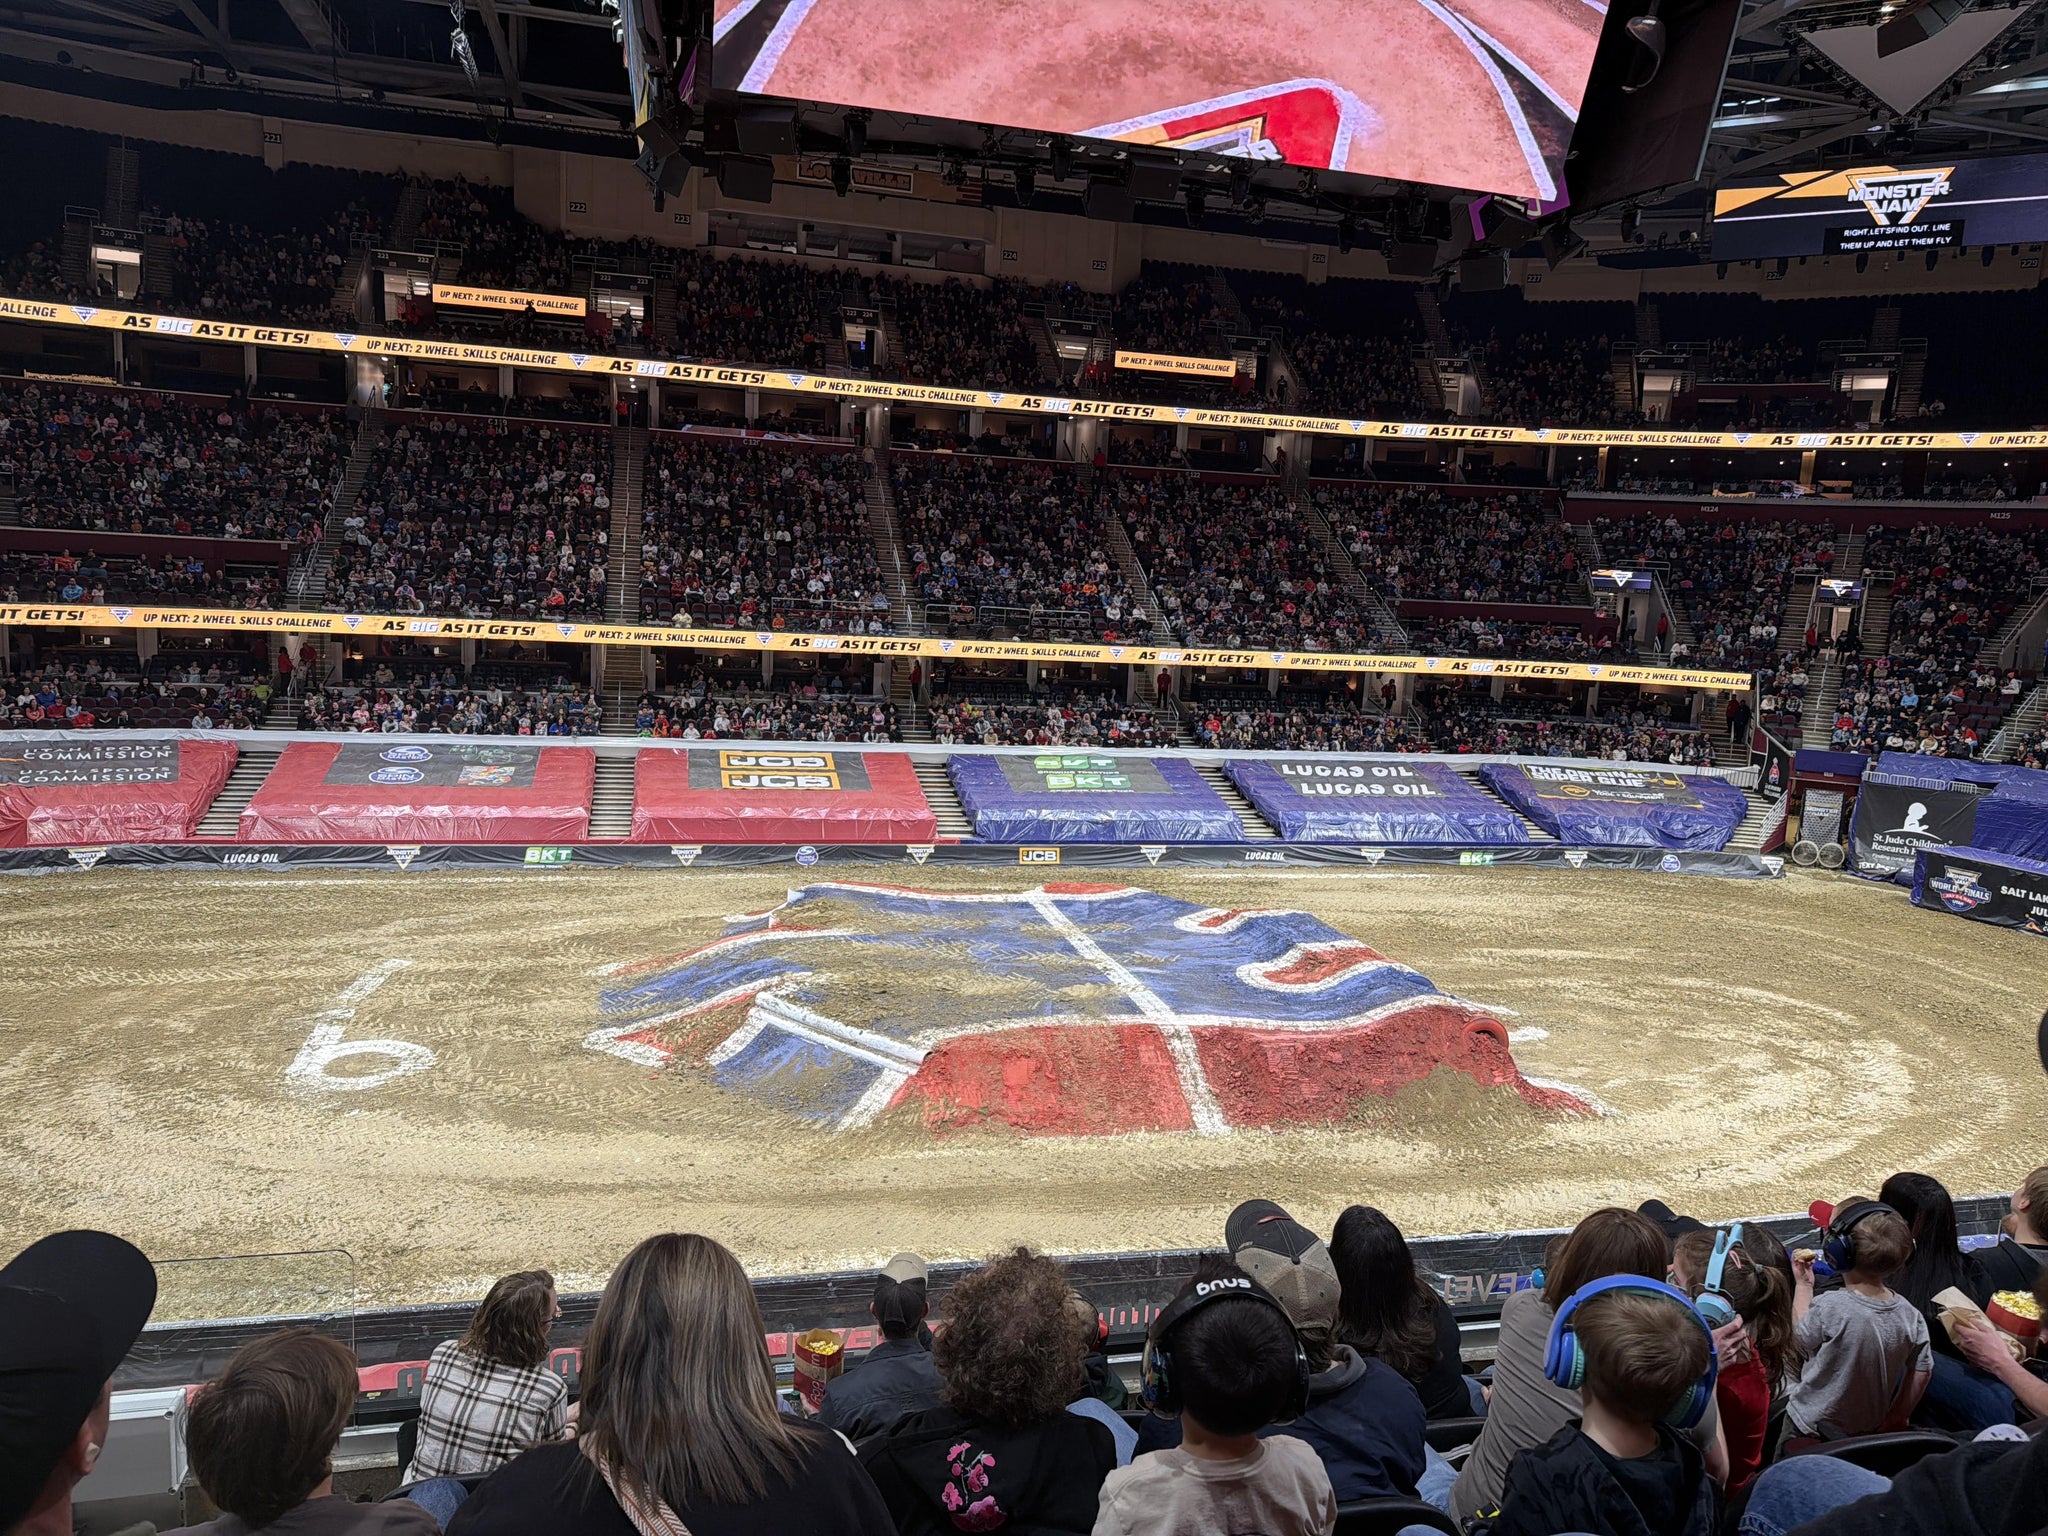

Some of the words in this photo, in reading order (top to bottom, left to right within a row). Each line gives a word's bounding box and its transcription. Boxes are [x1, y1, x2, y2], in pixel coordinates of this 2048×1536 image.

[264, 133, 280, 142] 221
[1848, 181, 1950, 202] MONSTER
[571, 203, 586, 211] 222
[1874, 198, 1920, 213] JAM
[675, 215, 690, 223] 223
[1932, 223, 1951, 231] LINE
[1840, 242, 1862, 250] THEM
[1935, 236, 1952, 244] FLY
[440, 290, 450, 298] UP
[452, 292, 474, 301] NEXT:
[482, 294, 507, 304] WHEEL
[509, 297, 535, 306] SKILLS
[537, 300, 579, 310] CHALLENGE
[0, 302, 58, 317] ALLENGE
[123, 316, 152, 328] AS
[156, 320, 194, 332] BIG
[196, 324, 225, 335] AS
[228, 327, 249, 337] IT
[254, 330, 311, 344] GETS!
[367, 340, 380, 349] UP
[381, 342, 413, 352] NEXT:
[416, 345, 423, 353] 2
[425, 345, 461, 356] WHEEL
[463, 348, 497, 359] SKILLS
[500, 352, 558, 364] CHALLENGE
[1153, 359, 1174, 367] WHEEL
[1175, 361, 1195, 369] SKILLS
[1196, 363, 1230, 372] CHALLENGE
[610, 361, 634, 371] AS
[636, 363, 668, 375] BIG
[670, 366, 693, 377] AS
[695, 368, 715, 378] IT
[718, 370, 766, 384] GETS!
[814, 380, 827, 388] UP
[828, 382, 853, 391] NEXT:
[864, 385, 895, 394] WHEEL
[896, 388, 927, 396] SKILLS
[928, 391, 978, 402] CHALLENGE
[1021, 398, 1042, 408] AS
[1044, 400, 1071, 411] BIG
[1072, 403, 1093, 411] AS
[1094, 404, 1111, 413] IT
[1113, 406, 1155, 417] GETS!
[1380, 425, 1400, 434] AS
[1430, 427, 1450, 436] AS
[1452, 428, 1469, 436] IT
[1471, 429, 1514, 439] GETS!
[1571, 433, 1596, 441] NEXT:
[1605, 434, 1635, 442] WHEEL
[1670, 435, 1723, 443] CHALLENGE
[1770, 436, 1795, 445] AS
[1831, 436, 1854, 445] AS
[1858, 436, 1879, 445] IT
[1880, 436, 1934, 445] GETS!
[1989, 436, 2003, 444] UP
[2004, 436, 2037, 444] NEXT:
[2040, 435, 2047, 443] 2
[0, 609, 22, 619] IT
[26, 610, 85, 620] GETS!
[143, 614, 160, 622] UP
[161, 614, 191, 622] NEXT:
[193, 615, 200, 623] 2
[202, 615, 237, 624] WHEEL
[240, 616, 274, 625] SKILLS
[276, 618, 333, 627] CHALLENGE
[383, 621, 405, 630] AS
[408, 622, 439, 633] BIG
[441, 624, 464, 633] AS
[467, 625, 486, 634] IT
[488, 626, 537, 636] GETS!
[599, 631, 624, 639] NEXT:
[634, 632, 664, 640] WHEEL
[666, 634, 696, 642] SKILLS
[698, 635, 747, 644] CHALLENGE
[790, 638, 810, 647] AS
[813, 639, 839, 649] BIG
[840, 640, 860, 649] AS
[862, 641, 879, 649] IT
[880, 642, 922, 651] GETS!
[1183, 653, 1201, 661] AS
[1202, 654, 1217, 662] IT
[1218, 654, 1255, 663] GETS!
[1452, 662, 1470, 670] AS
[1495, 664, 1513, 672] AS
[1531, 666, 1570, 674] GETS!
[1652, 673, 1679, 681] WHEEL
[1681, 675, 1709, 683] SKILLS
[1710, 676, 1751, 686] CHALLENG
[23, 751, 170, 760] COMMISSION
[729, 756, 825, 767] JCB
[1282, 764, 1364, 778] LUCAS
[18, 772, 169, 783] COMMISSION
[731, 775, 830, 788] JCB
[1532, 772, 1593, 783] SUPER
[1598, 777, 1646, 788] GLUE
[1300, 783, 1386, 795] LUCAS
[1873, 833, 1884, 842] St.
[1884, 835, 1905, 845] Jude
[1872, 842, 1910, 854] Research
[223, 853, 260, 863] LUCAS
[261, 853, 279, 862] OIL
[526, 849, 572, 861] BKT
[1023, 851, 1056, 861] JCB
[1245, 852, 1271, 861] LUCAS
[1272, 852, 1285, 861] OIL
[1460, 853, 1493, 864] BKT
[1931, 880, 1958, 893] WORLD
[1964, 887, 1990, 901] FINALS
[2000, 885, 2027, 899] SALT
[2028, 891, 2048, 904] LAK
[2031, 906, 2048, 917] JUL
